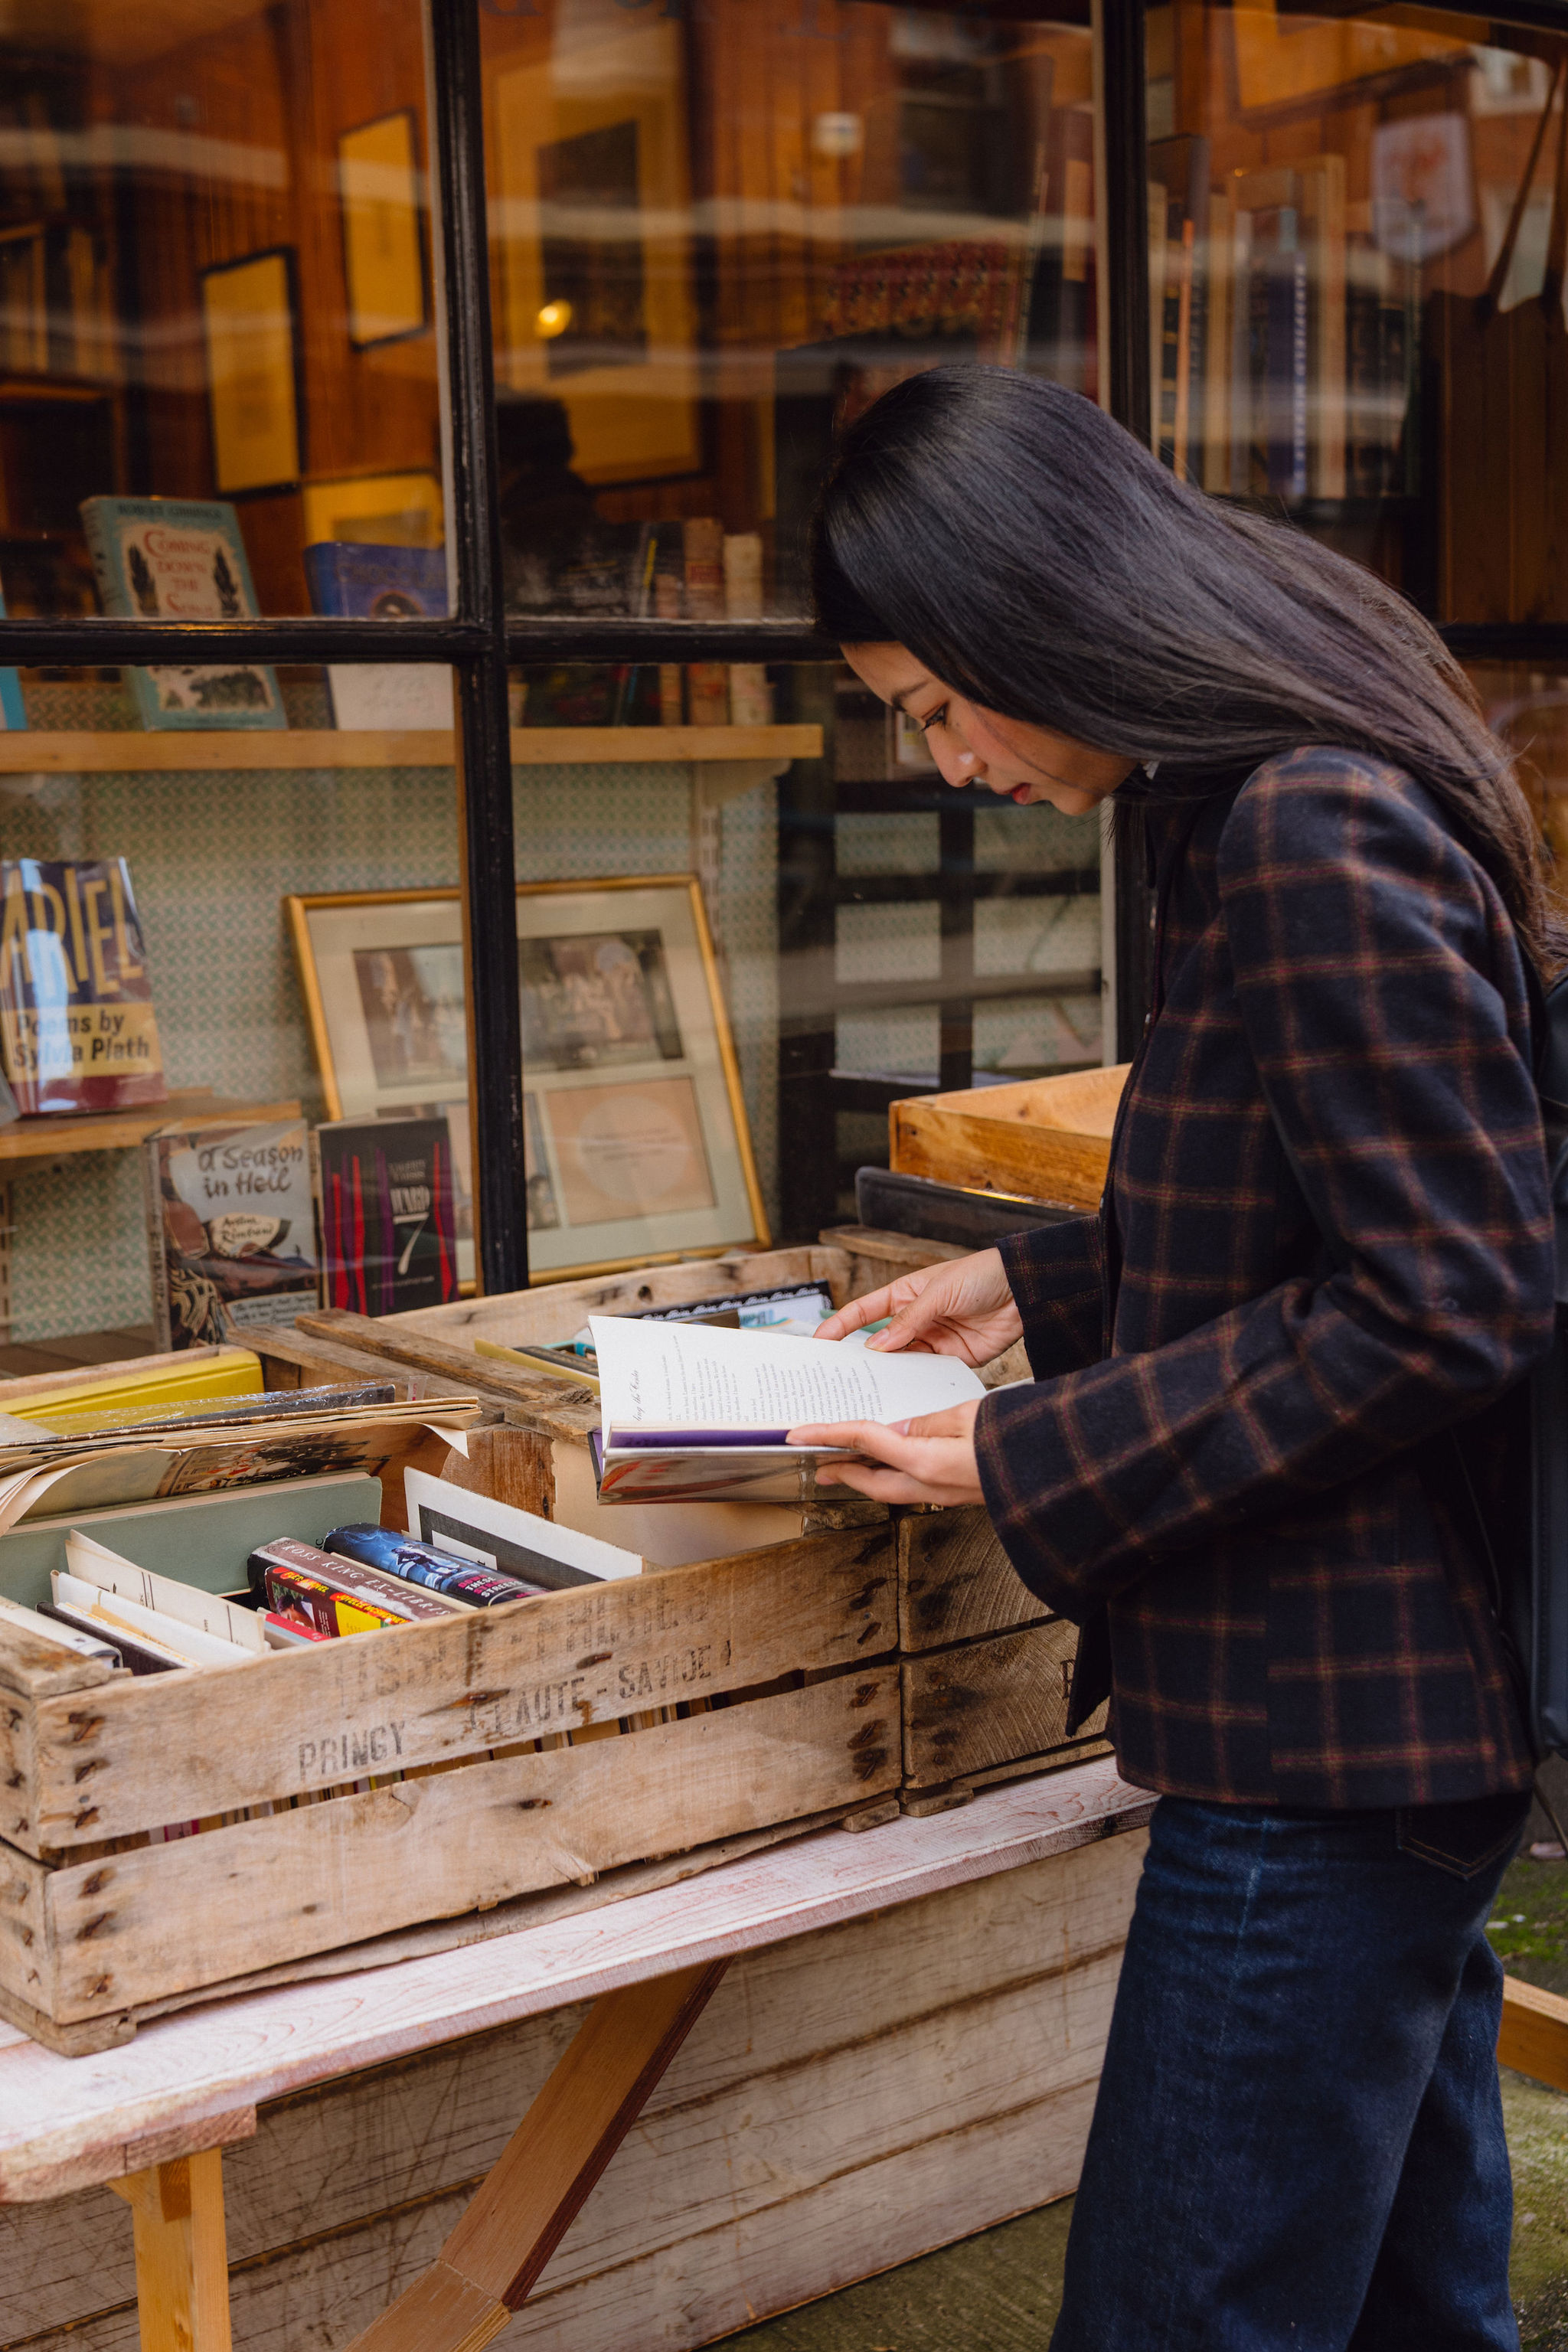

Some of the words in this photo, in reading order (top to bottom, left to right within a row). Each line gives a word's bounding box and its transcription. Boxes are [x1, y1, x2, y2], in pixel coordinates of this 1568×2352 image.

[0, 867, 144, 995] ARIEL
[100, 1008, 125, 1037] by
[91, 1036, 150, 1060] Plath
[222, 1145, 303, 1170] Season
[204, 1177, 229, 1198] in
[236, 1166, 292, 1194] Hell
[392, 1211, 430, 1276] 7
[283, 1544, 321, 1561] ROSS
[322, 1561, 364, 1579] KING
[365, 1579, 451, 1615] EX-LIBRIS
[465, 1576, 496, 1591] THESE
[481, 1580, 523, 1598] STREETS
[298, 1720, 405, 1782] PRINGY
